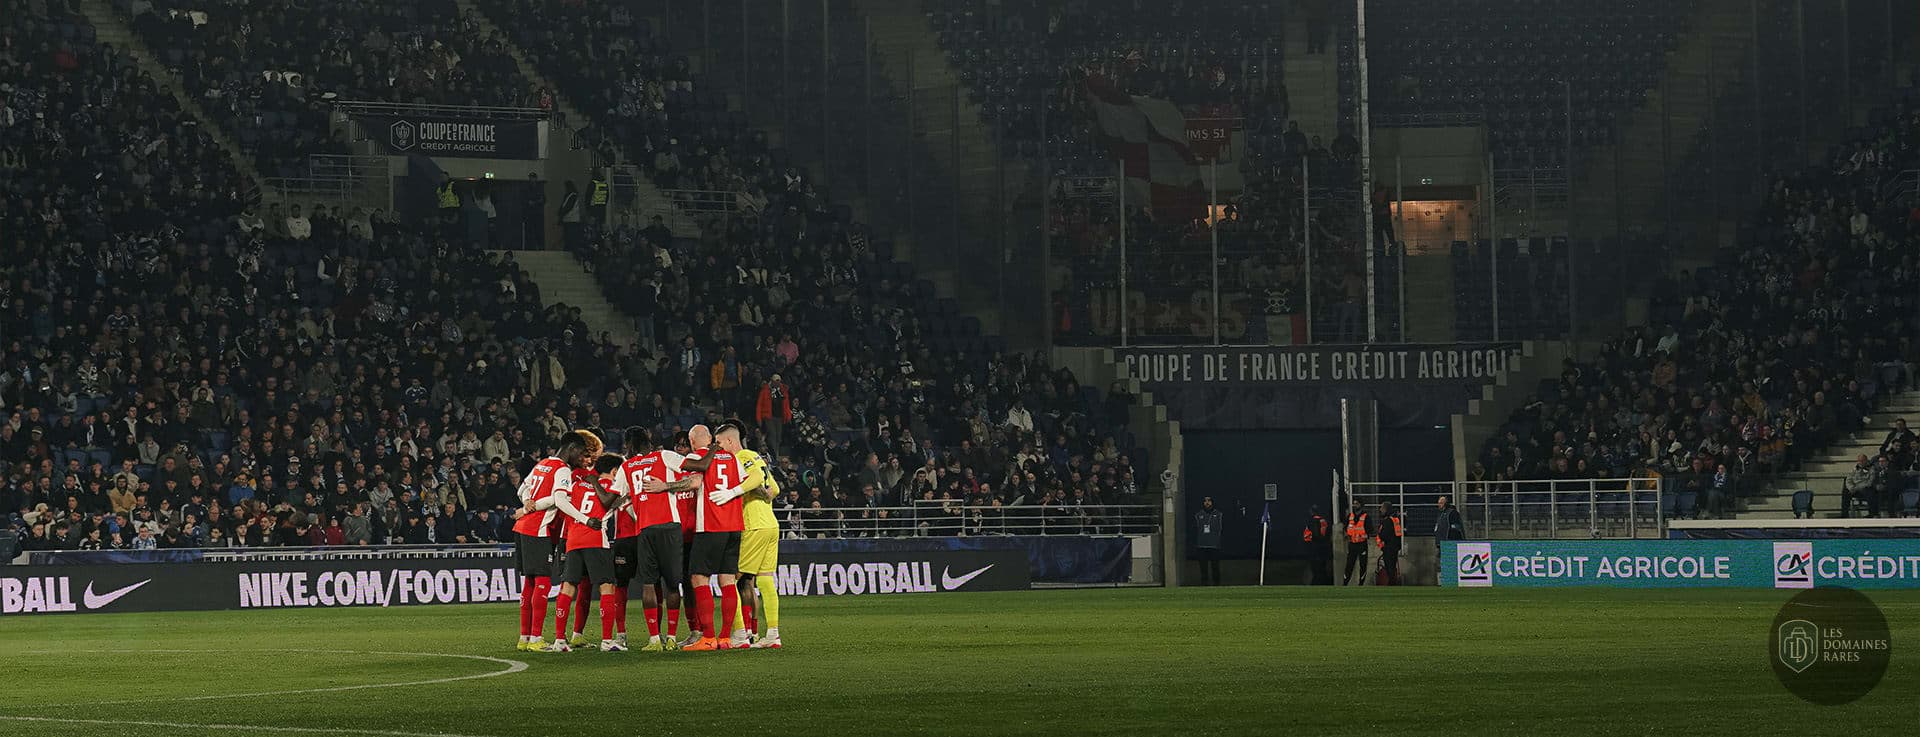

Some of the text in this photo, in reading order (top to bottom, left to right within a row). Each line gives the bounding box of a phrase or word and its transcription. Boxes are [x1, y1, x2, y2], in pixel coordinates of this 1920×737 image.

[420, 122, 451, 140] COUPE
[458, 123, 496, 142] FRANCE
[1212, 128, 1225, 139] 51
[453, 143, 497, 152] AGRICOLE
[1125, 346, 1520, 382] COUPE DE FRANCE CRÉDIT AGRICOL
[716, 463, 729, 491] 5
[580, 491, 596, 514] 6
[1495, 551, 1589, 577] CRÉDIT
[1596, 556, 1731, 578] AGRICOLE
[1817, 550, 1920, 579] CRÉDIT
[776, 561, 937, 597] M/FOOTBALL
[0, 576, 77, 613] BALL
